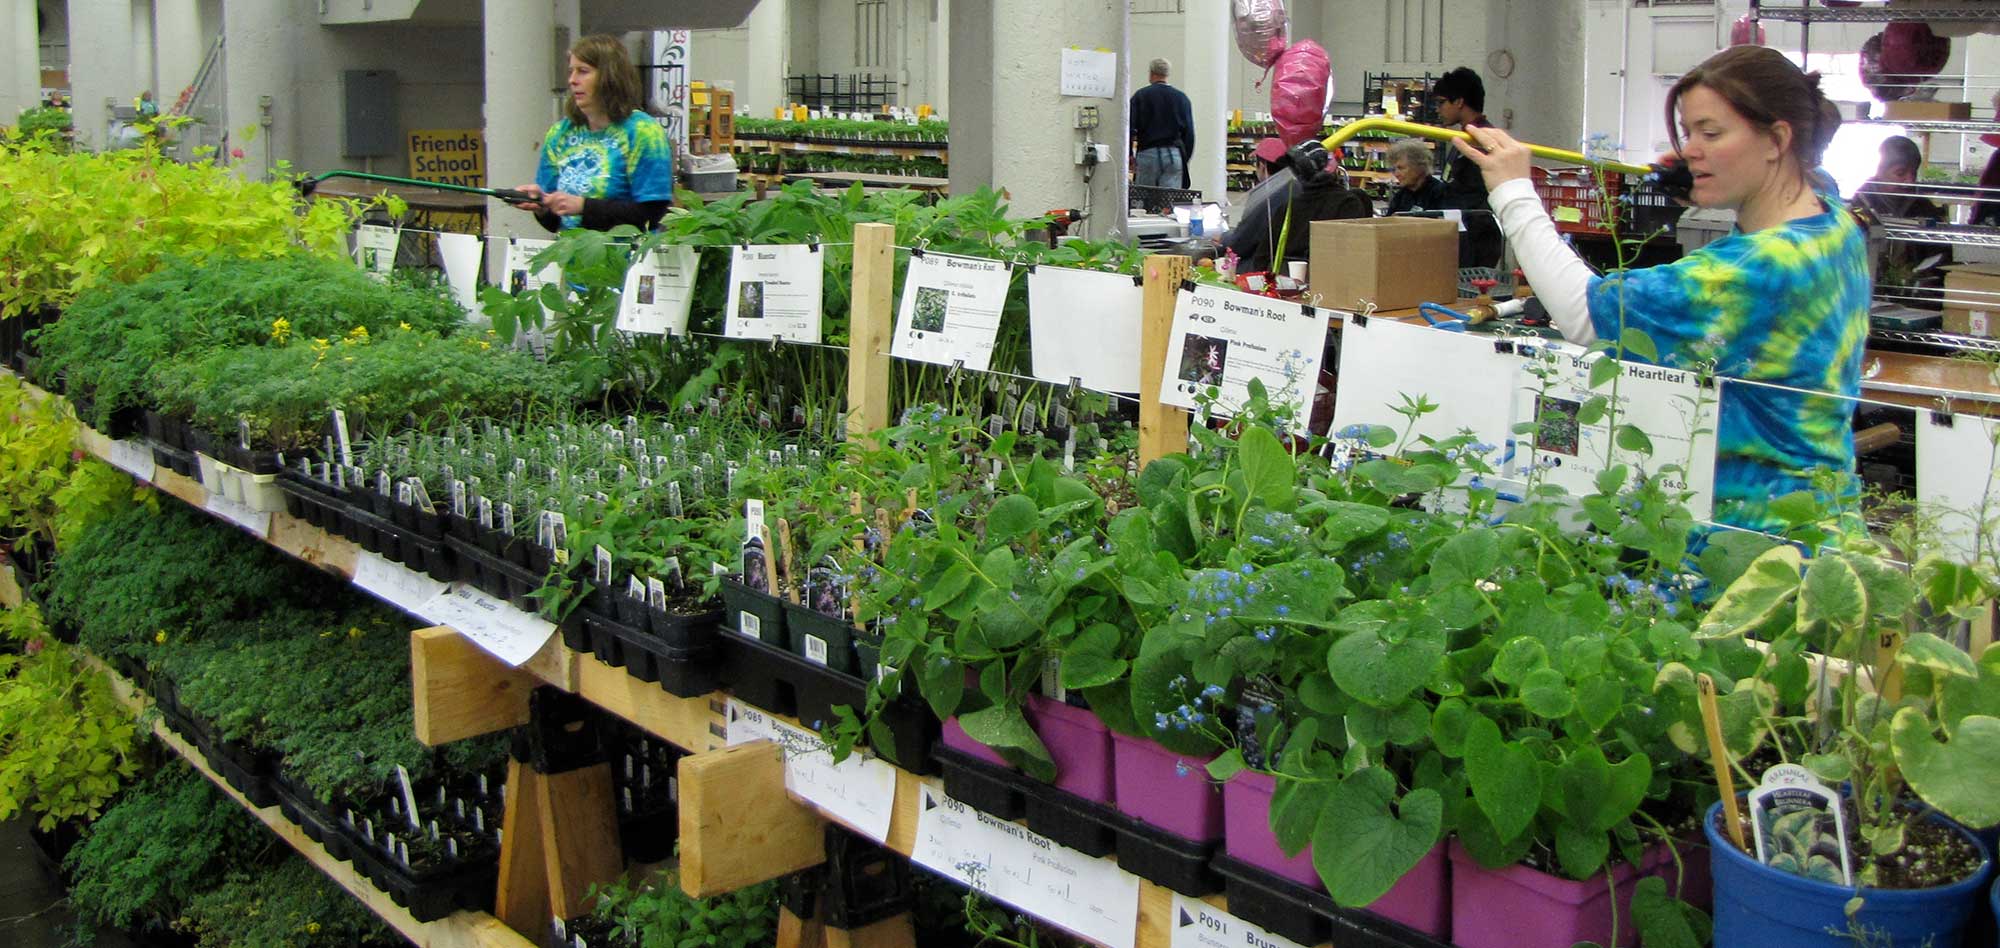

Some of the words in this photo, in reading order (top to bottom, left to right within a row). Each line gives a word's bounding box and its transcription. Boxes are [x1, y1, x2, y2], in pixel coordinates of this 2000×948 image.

[411, 133, 479, 152] Friends
[415, 154, 478, 173] School
[946, 258, 982, 271] Bowman's
[1190, 295, 1215, 309] P090
[1223, 300, 1265, 318] Bowman's
[1266, 308, 1287, 322] Root
[1628, 365, 1687, 384] Heartleaf
[976, 810, 1025, 840] Bowman's
[1026, 831, 1052, 851] Root
[1199, 911, 1228, 935] P091
[1246, 931, 1282, 948] Brun
